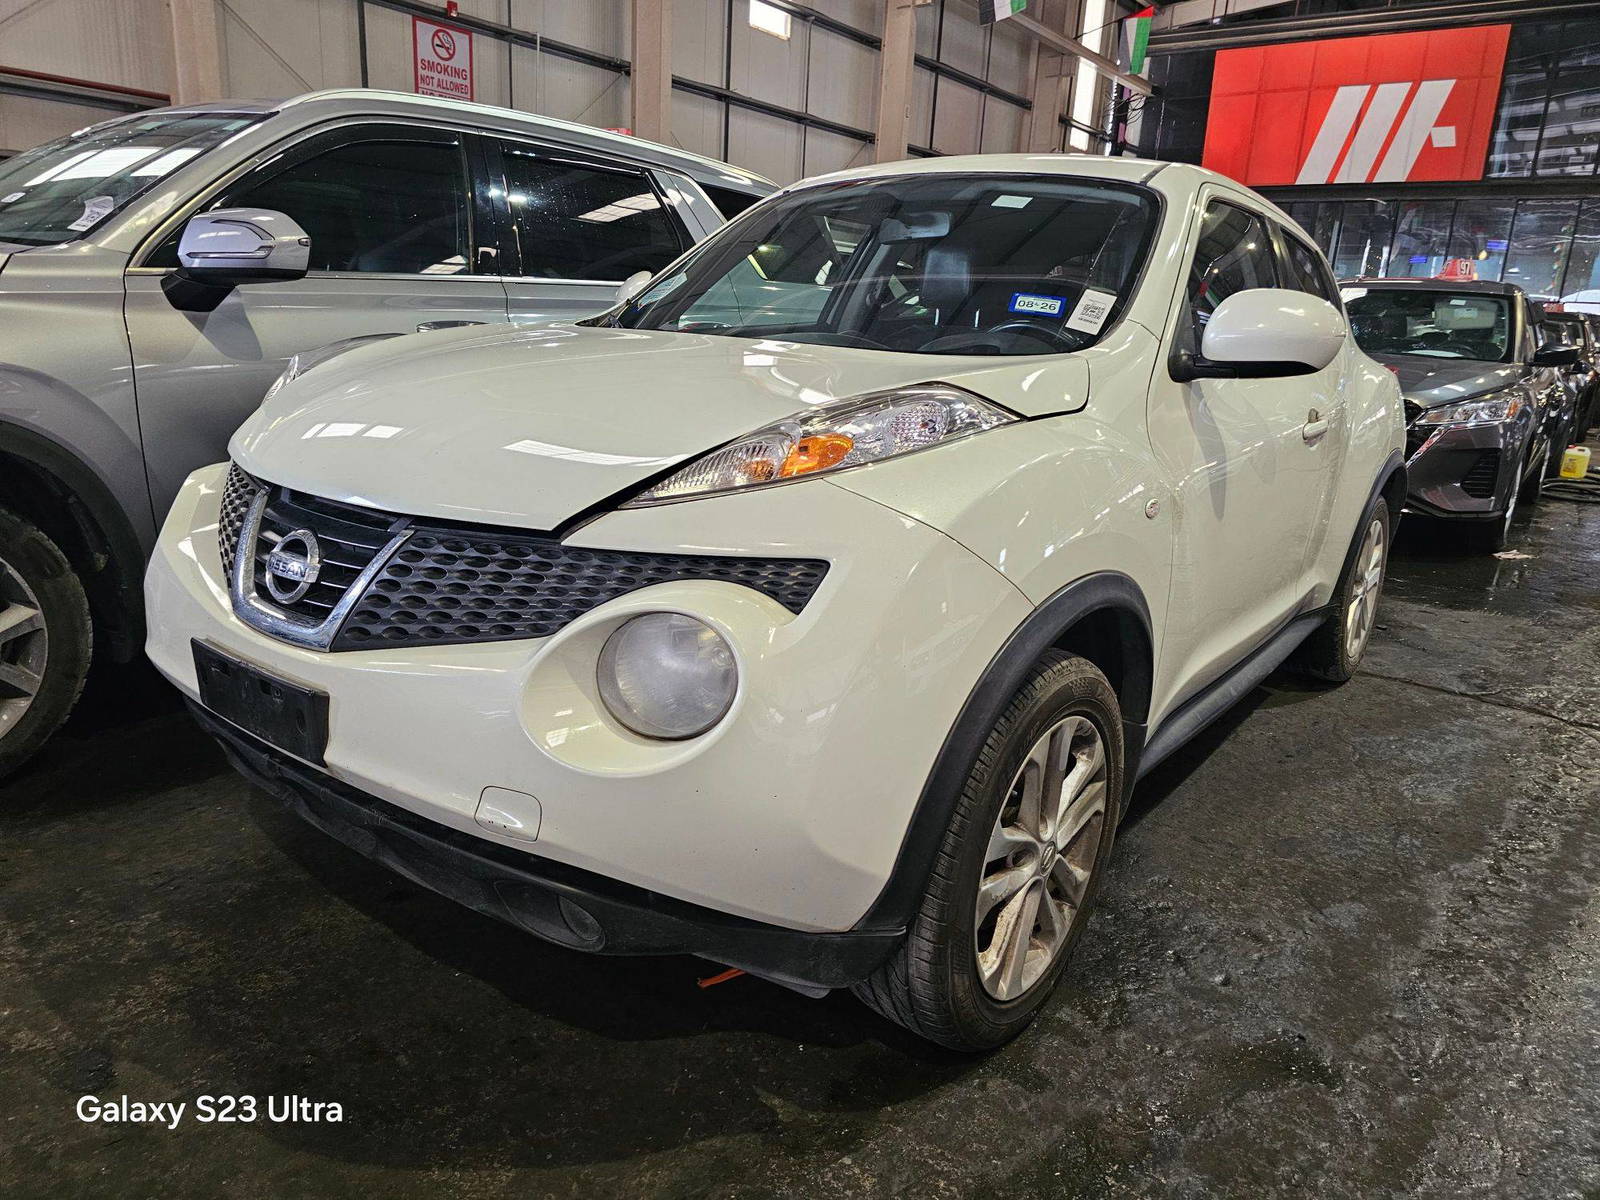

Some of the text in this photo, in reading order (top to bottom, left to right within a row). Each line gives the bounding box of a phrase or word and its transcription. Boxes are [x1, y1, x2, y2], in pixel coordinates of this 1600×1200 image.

[420, 59, 468, 80] SMOKING
[420, 74, 435, 87] NOT
[436, 78, 469, 95] ALLOWED
